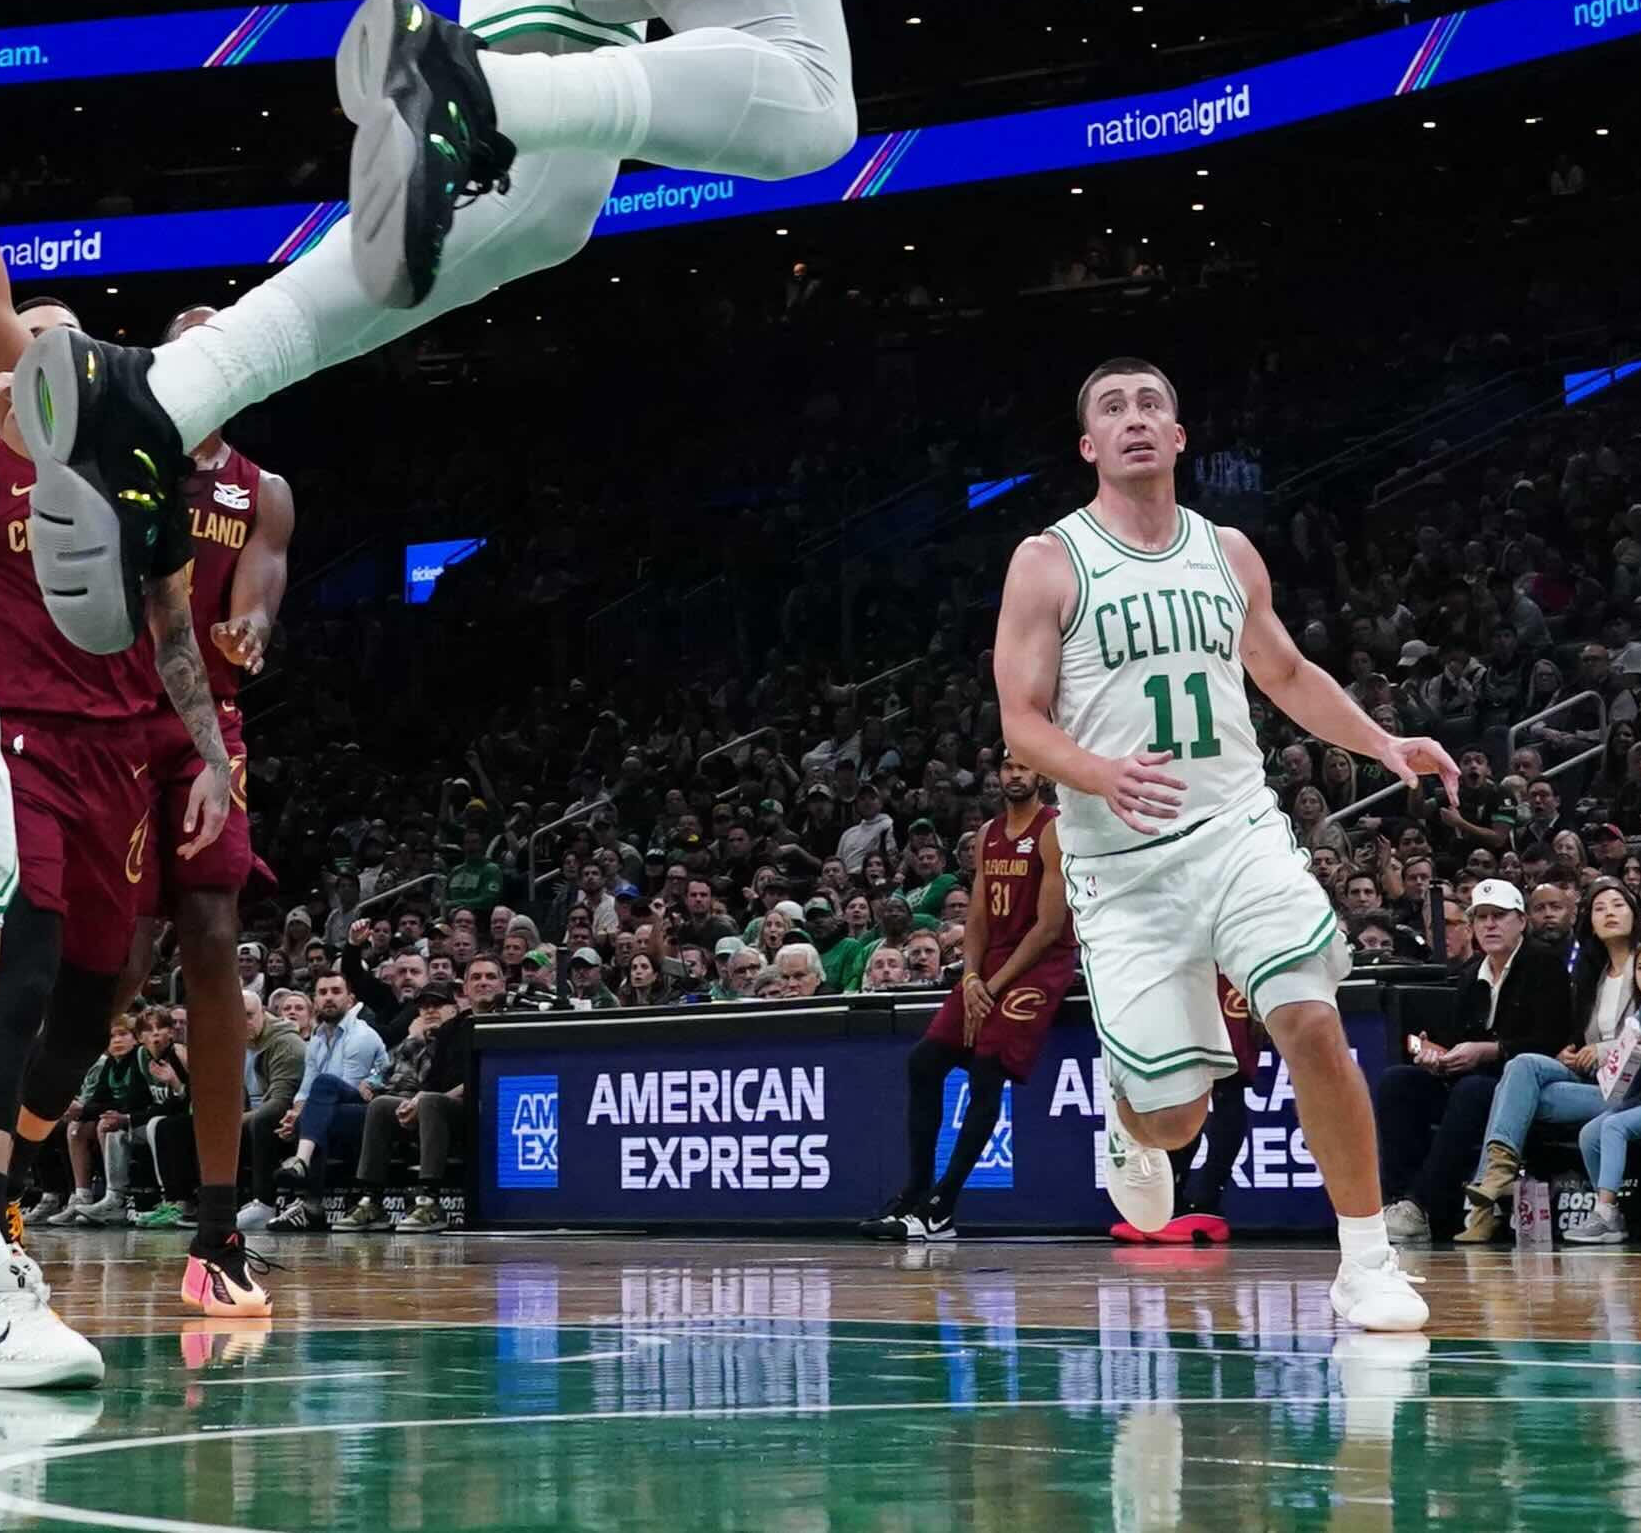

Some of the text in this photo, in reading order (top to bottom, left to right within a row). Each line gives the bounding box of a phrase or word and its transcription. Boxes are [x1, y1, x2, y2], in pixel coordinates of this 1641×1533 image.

[1086, 84, 1251, 147] nationalgrid
[0, 229, 102, 271] nalgrid
[1095, 588, 1234, 671] CELTICS
[1144, 671, 1222, 760] 11
[990, 881, 1011, 916] 31
[586, 1066, 825, 1125] AMERICAN
[620, 1134, 830, 1189] EXPRESS
